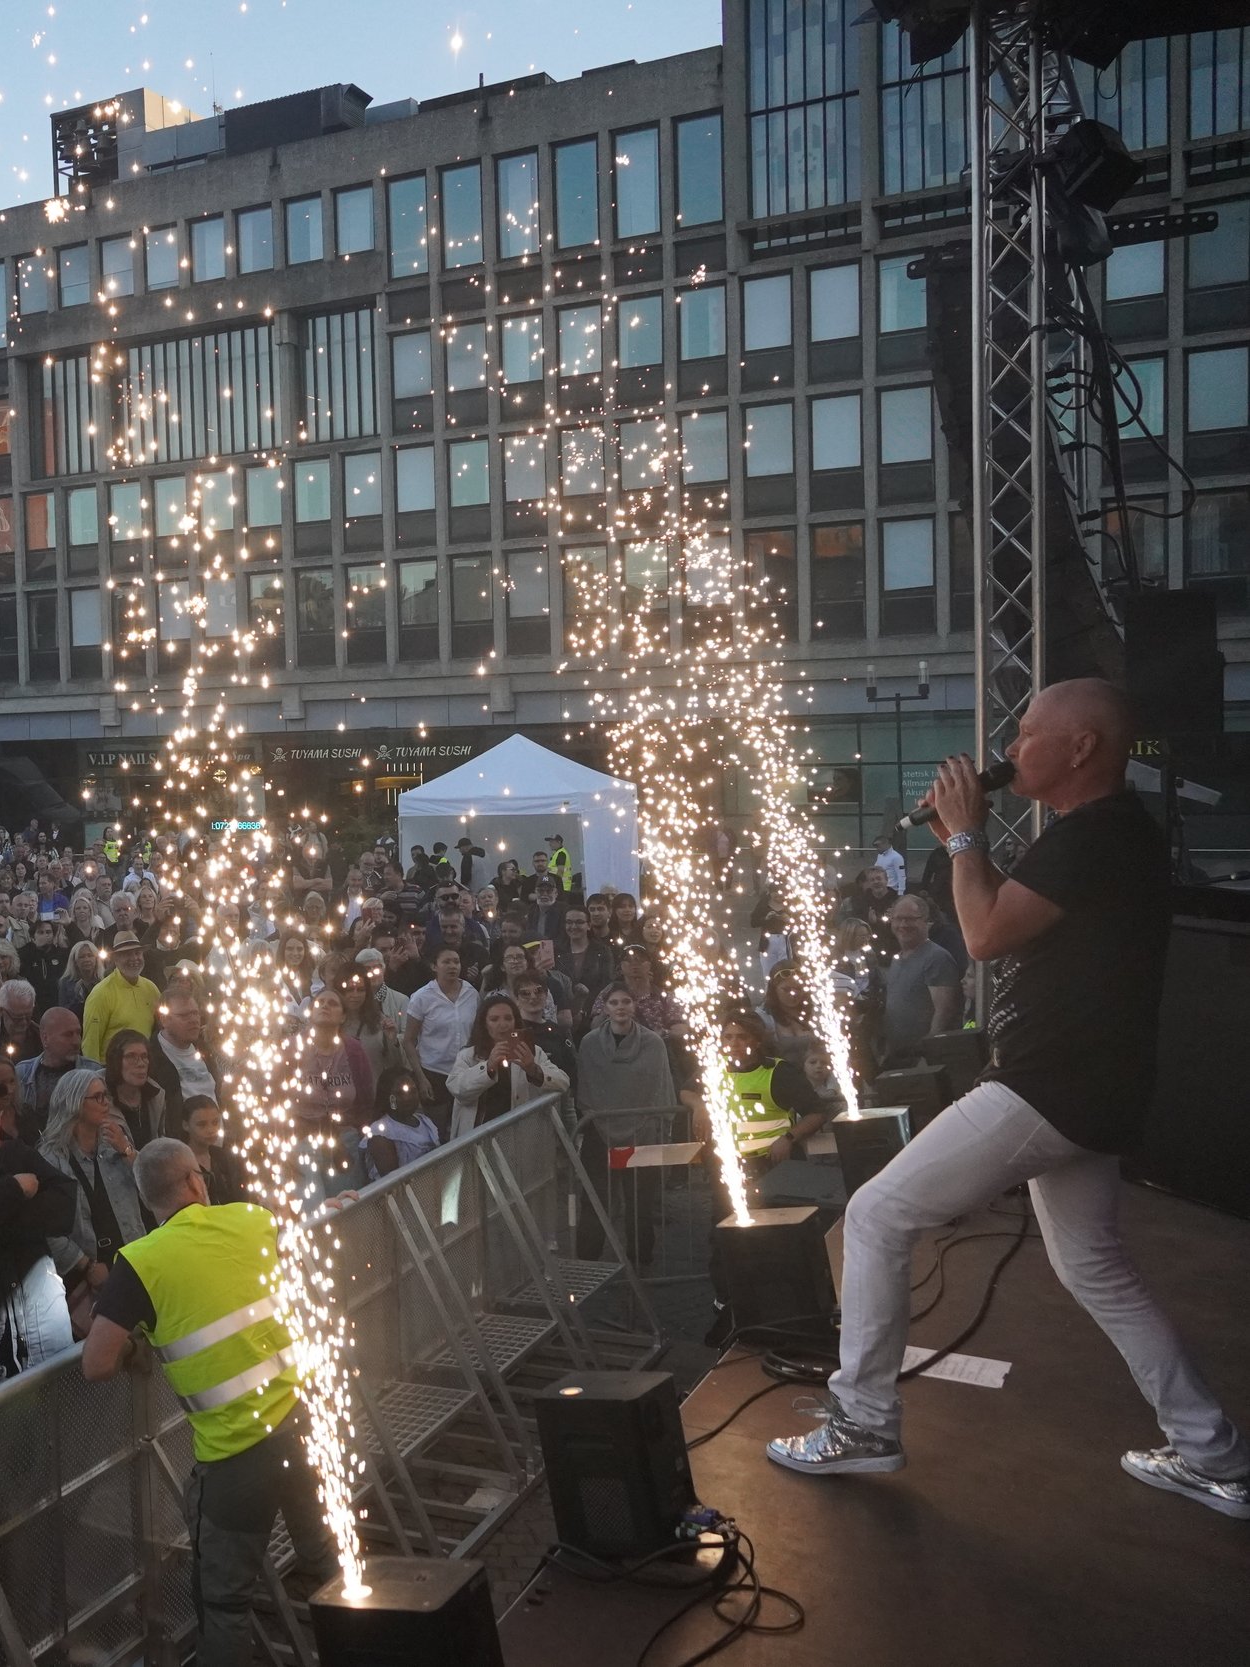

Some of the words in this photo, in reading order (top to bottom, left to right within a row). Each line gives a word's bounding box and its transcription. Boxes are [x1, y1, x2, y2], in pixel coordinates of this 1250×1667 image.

[291, 748, 329, 759] TUYAMA
[331, 748, 362, 758] SUSHI
[396, 746, 437, 757] TUYAMA
[439, 745, 472, 756] SUSHI
[118, 752, 157, 765] NAILS
